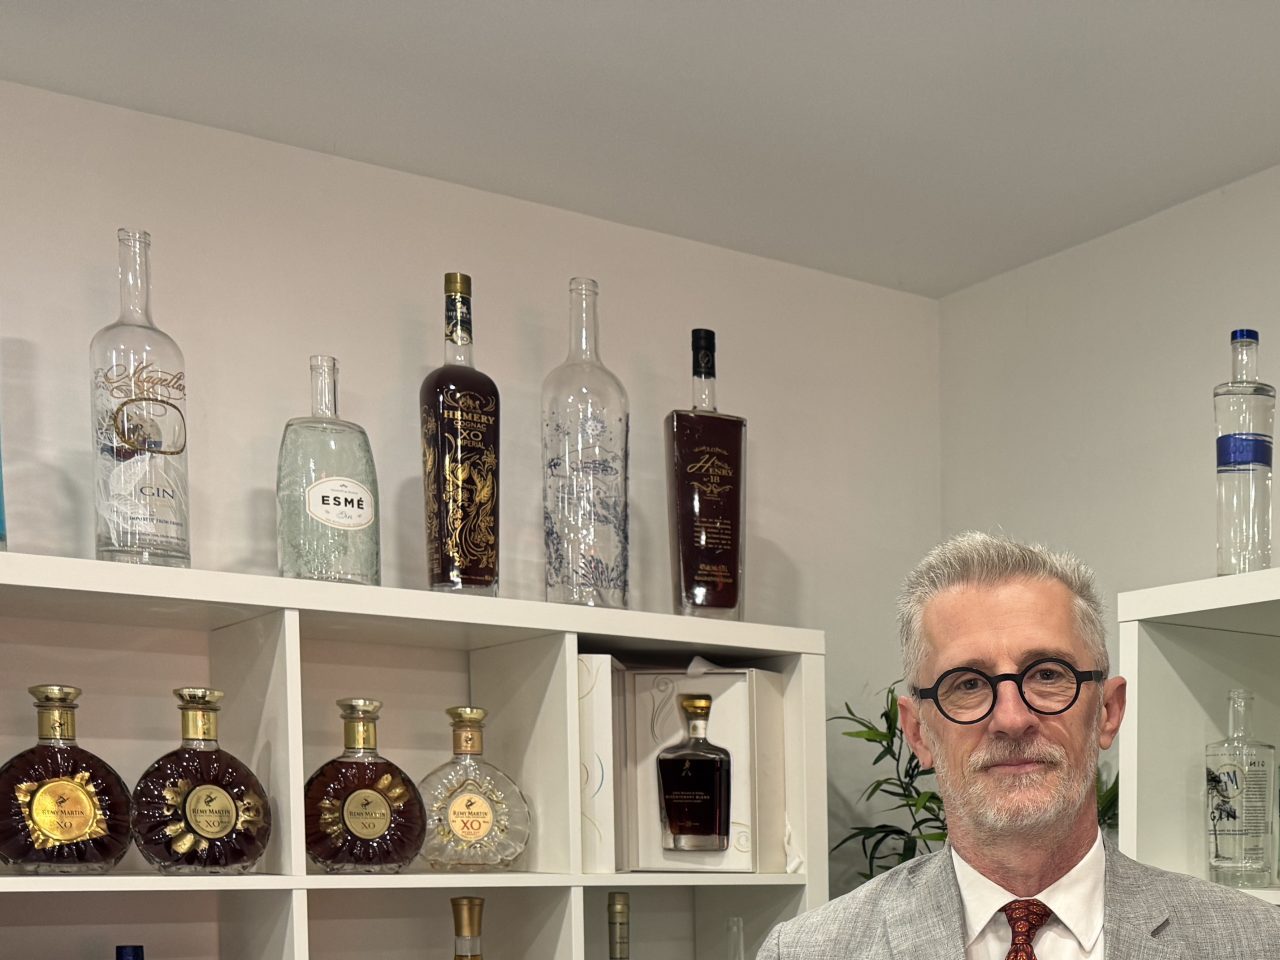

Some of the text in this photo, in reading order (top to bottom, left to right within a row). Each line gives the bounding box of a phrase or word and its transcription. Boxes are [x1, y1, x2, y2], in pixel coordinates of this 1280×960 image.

[443, 410, 496, 425] HEMERY
[453, 419, 488, 431] COGNAC
[458, 429, 483, 442] XO
[139, 486, 175, 500] GIN
[321, 495, 365, 510] ESMÉ
[468, 810, 489, 818] MARTIN
[1210, 811, 1237, 821] GIN
[56, 820, 73, 830] XO
[205, 820, 221, 828] XO
[361, 821, 376, 830] XO
[461, 820, 482, 831] XO
